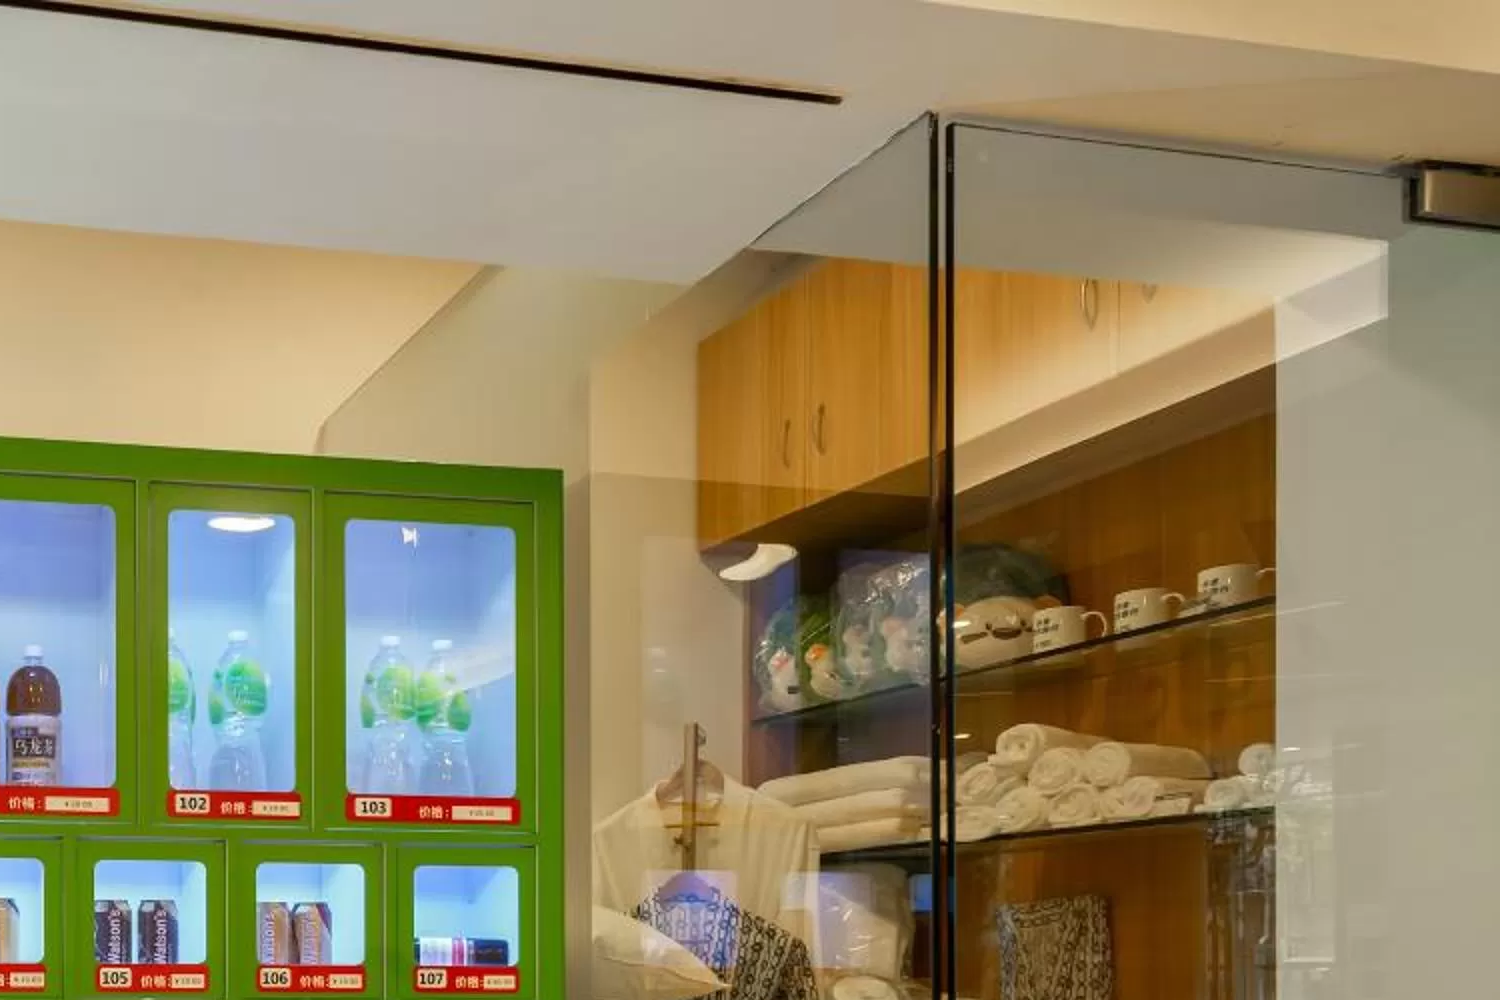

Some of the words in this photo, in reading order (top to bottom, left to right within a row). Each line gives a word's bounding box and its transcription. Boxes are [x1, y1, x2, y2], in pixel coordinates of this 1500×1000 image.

[179, 798, 206, 810] 102
[361, 802, 387, 814] 103
[107, 909, 121, 964] Watson's
[153, 909, 168, 964] Watson's
[102, 972, 128, 985] 105
[263, 972, 288, 985] 106
[420, 972, 444, 984] 107
